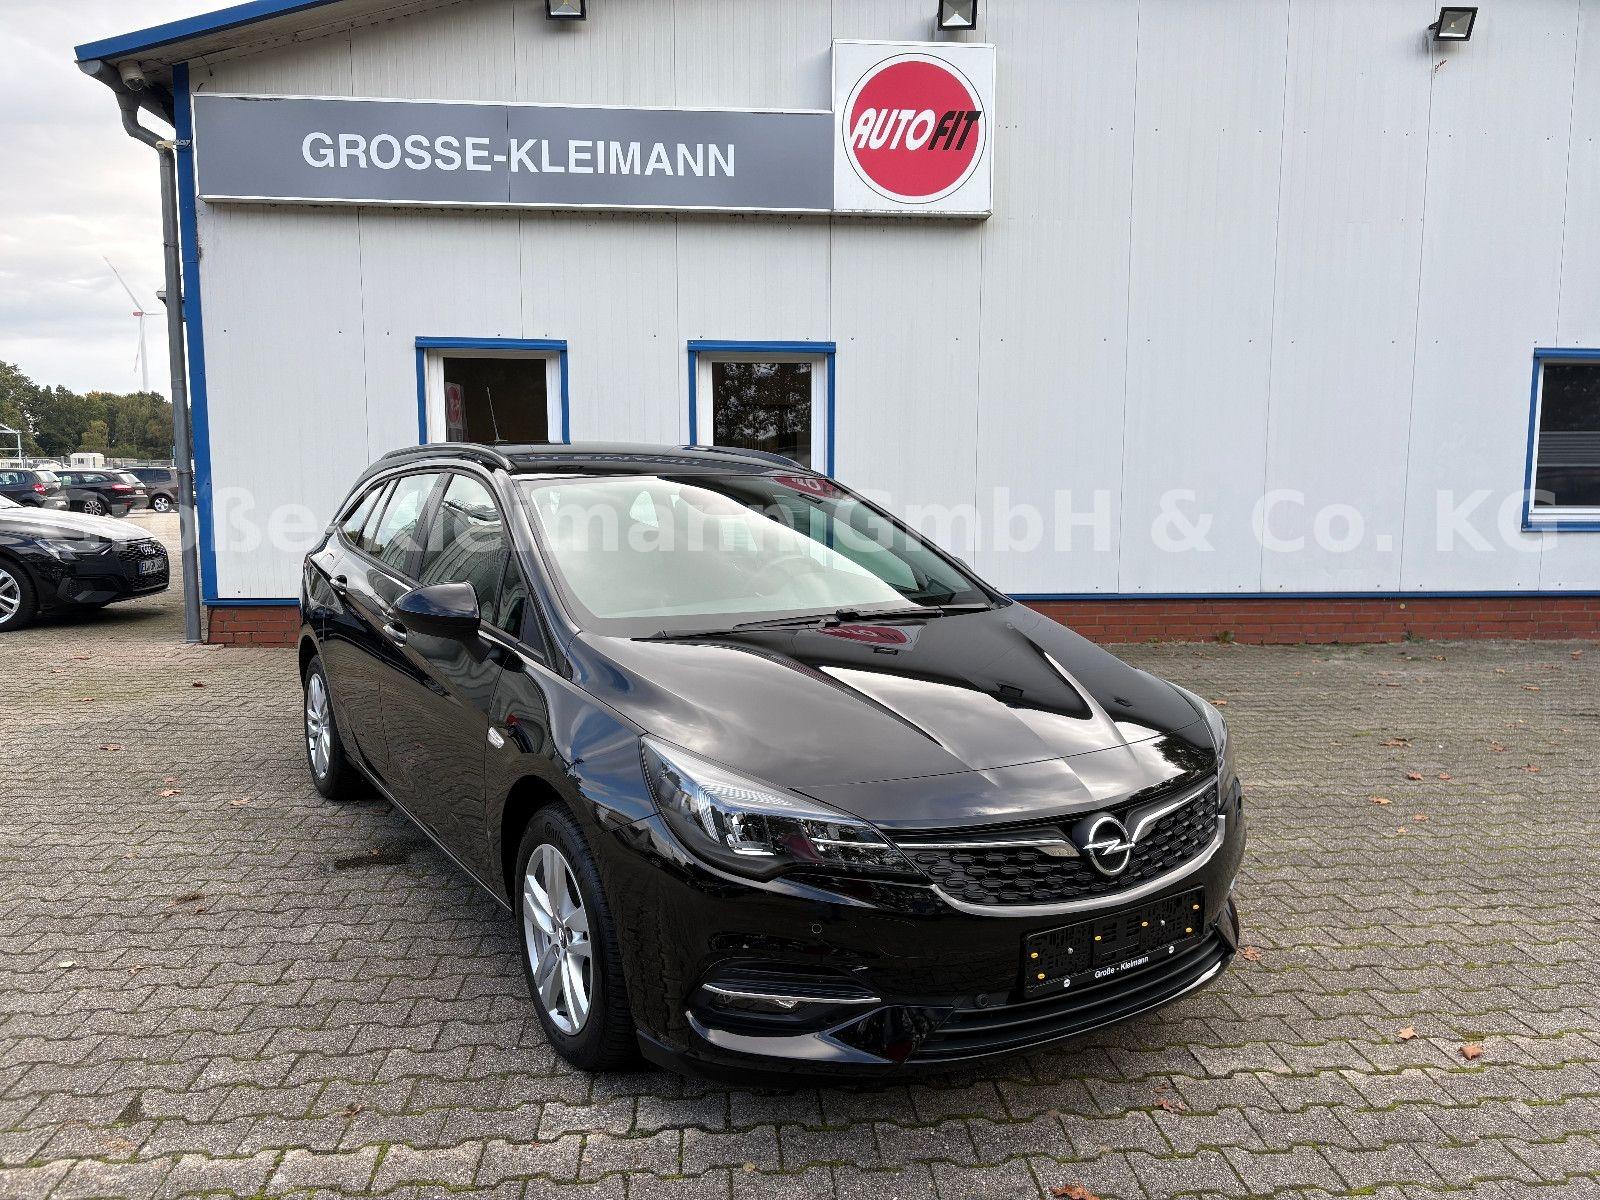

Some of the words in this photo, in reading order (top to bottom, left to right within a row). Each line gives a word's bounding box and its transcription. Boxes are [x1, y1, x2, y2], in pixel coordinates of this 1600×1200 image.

[850, 107, 982, 151] AUTOFIT
[302, 131, 735, 178] GROSSE-KLEIMANN
[1095, 967, 1115, 978] Große
[1120, 956, 1149, 971] Kleimann
